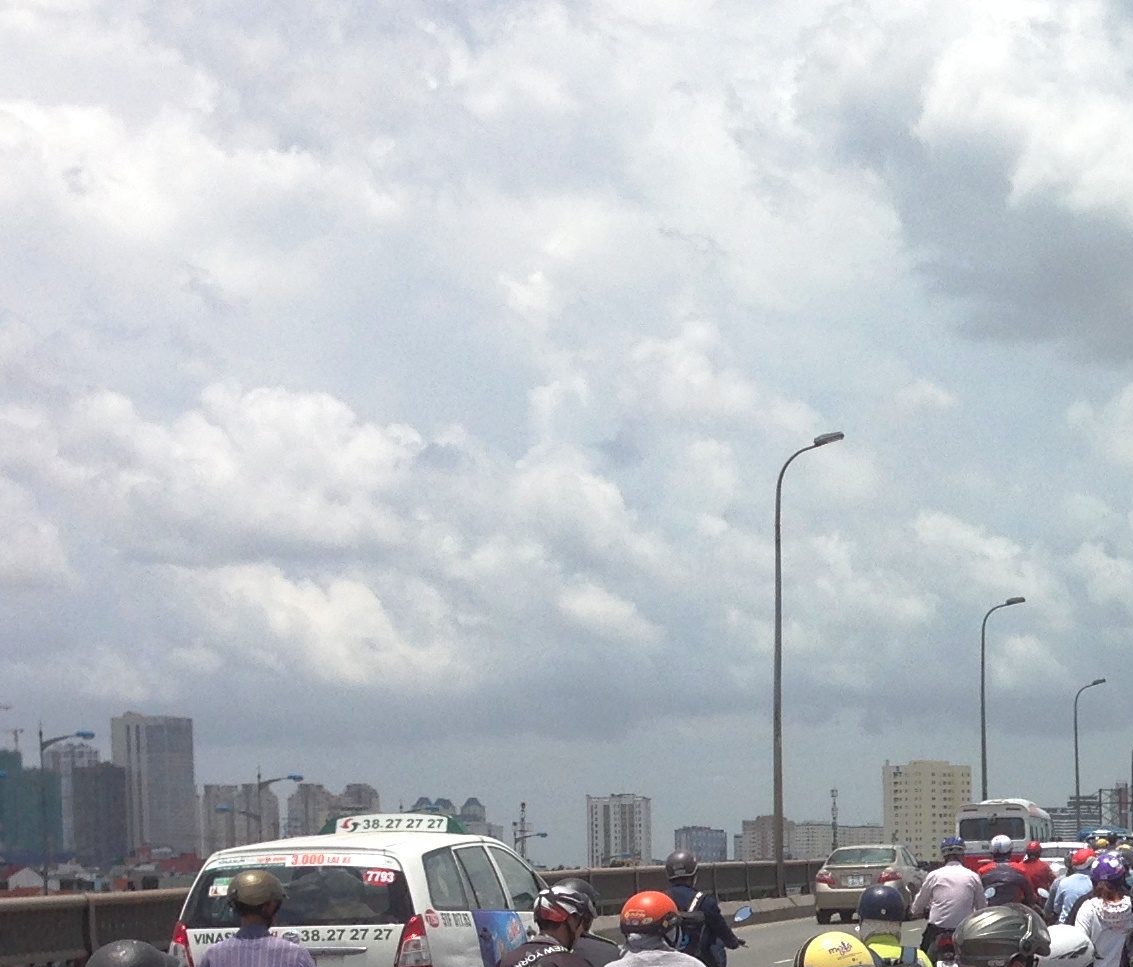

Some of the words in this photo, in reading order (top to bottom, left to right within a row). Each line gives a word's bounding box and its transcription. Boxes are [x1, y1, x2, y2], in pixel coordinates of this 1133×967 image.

[363, 819, 402, 829] 38.27
[406, 818, 423, 828] 27
[427, 819, 444, 829] 27
[291, 854, 324, 865] 3.000
[366, 871, 394, 882] 7793
[193, 931, 236, 945] VINAS
[301, 929, 346, 942] 38.27
[350, 929, 369, 940] 27
[373, 929, 393, 940] 27
